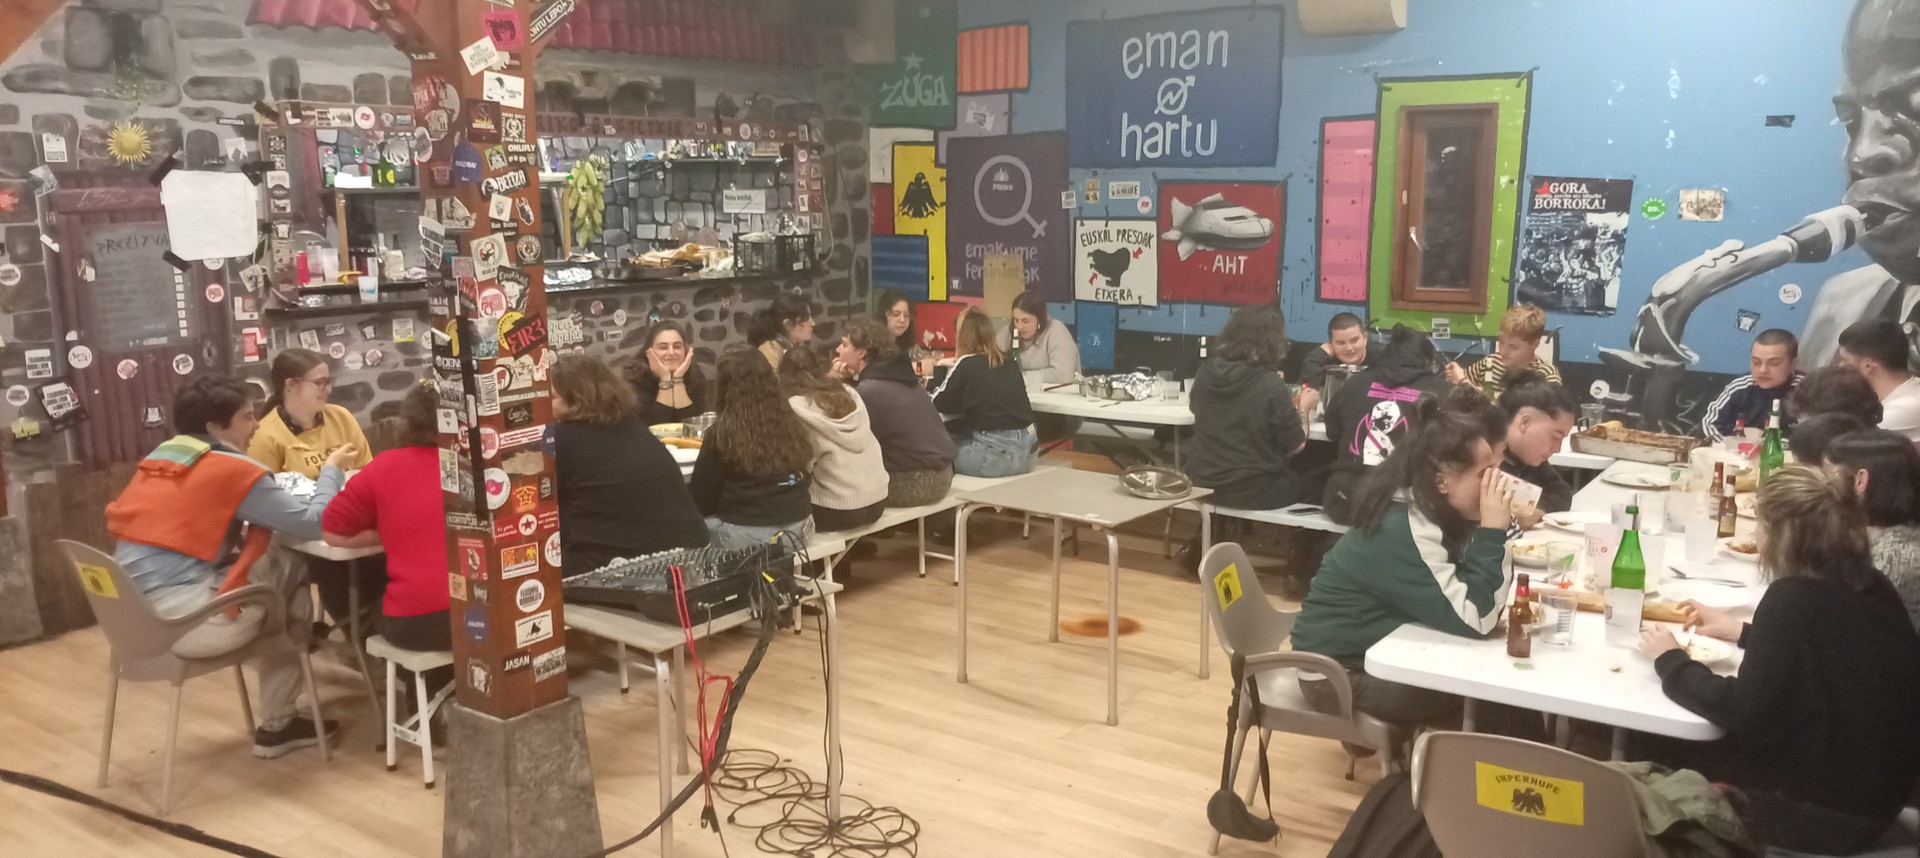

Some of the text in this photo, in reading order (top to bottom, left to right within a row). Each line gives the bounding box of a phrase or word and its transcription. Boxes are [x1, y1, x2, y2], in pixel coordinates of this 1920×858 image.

[1122, 29, 1229, 80] eman
[1120, 112, 1218, 162] hartu
[1549, 182, 1589, 194] GORA
[1533, 198, 1607, 210] BORROKA!
[1080, 228, 1155, 250] EUSKAL PRESOAK
[1212, 254, 1249, 275] AHT
[1095, 287, 1133, 301] ETXERA
[504, 654, 530, 672] JASAN
